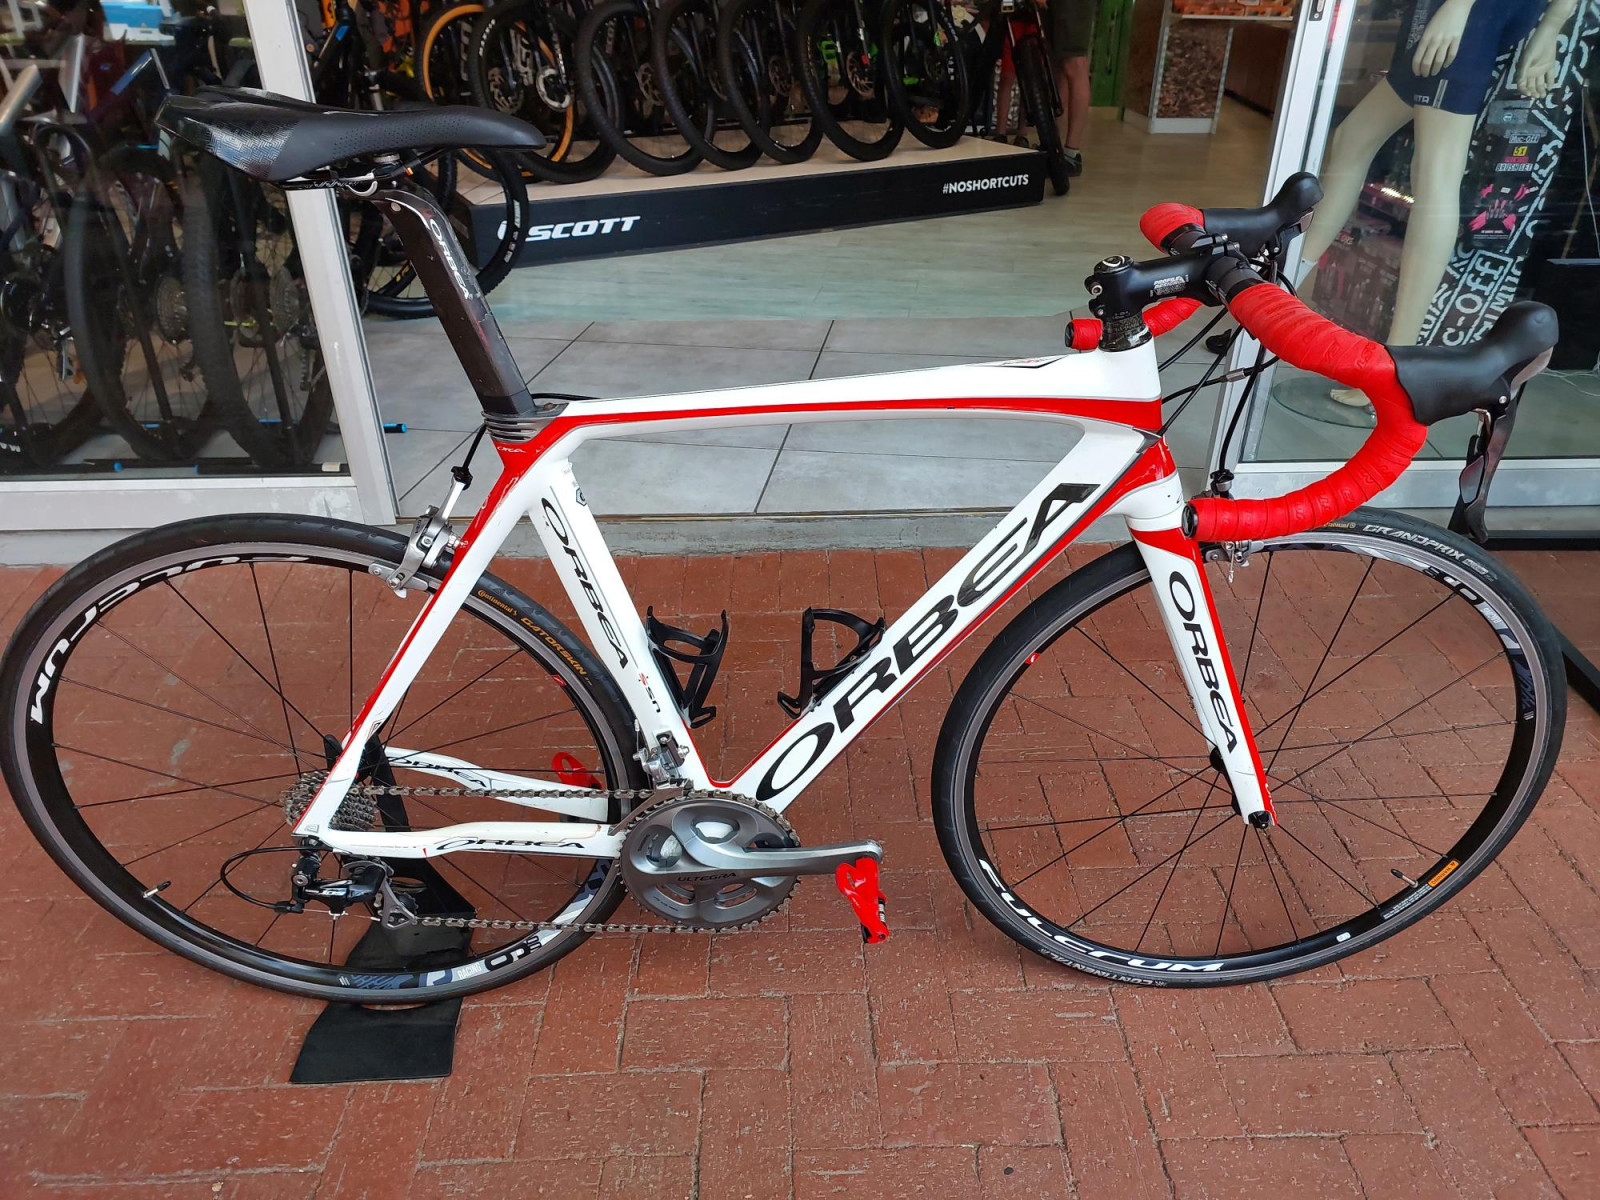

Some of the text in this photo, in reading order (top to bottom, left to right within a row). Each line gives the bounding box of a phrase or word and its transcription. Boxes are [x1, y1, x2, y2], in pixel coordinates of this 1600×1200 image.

[942, 174, 1029, 194] #NOSHORTCUTS
[525, 215, 641, 242] SCOTT
[429, 218, 470, 300] ORBEA
[541, 497, 629, 669] ORBEA
[477, 589, 514, 614] Continental
[520, 616, 588, 676] GATORSKIN
[755, 483, 1101, 801] ORBEA
[1169, 570, 1238, 754] ORBEA
[436, 839, 585, 850] ORBEA
[677, 872, 737, 881] ULTEGRA
[979, 858, 1225, 972] FULCRUM
[457, 961, 482, 980] RACING
[1048, 951, 1155, 986] CONTINENTAL
